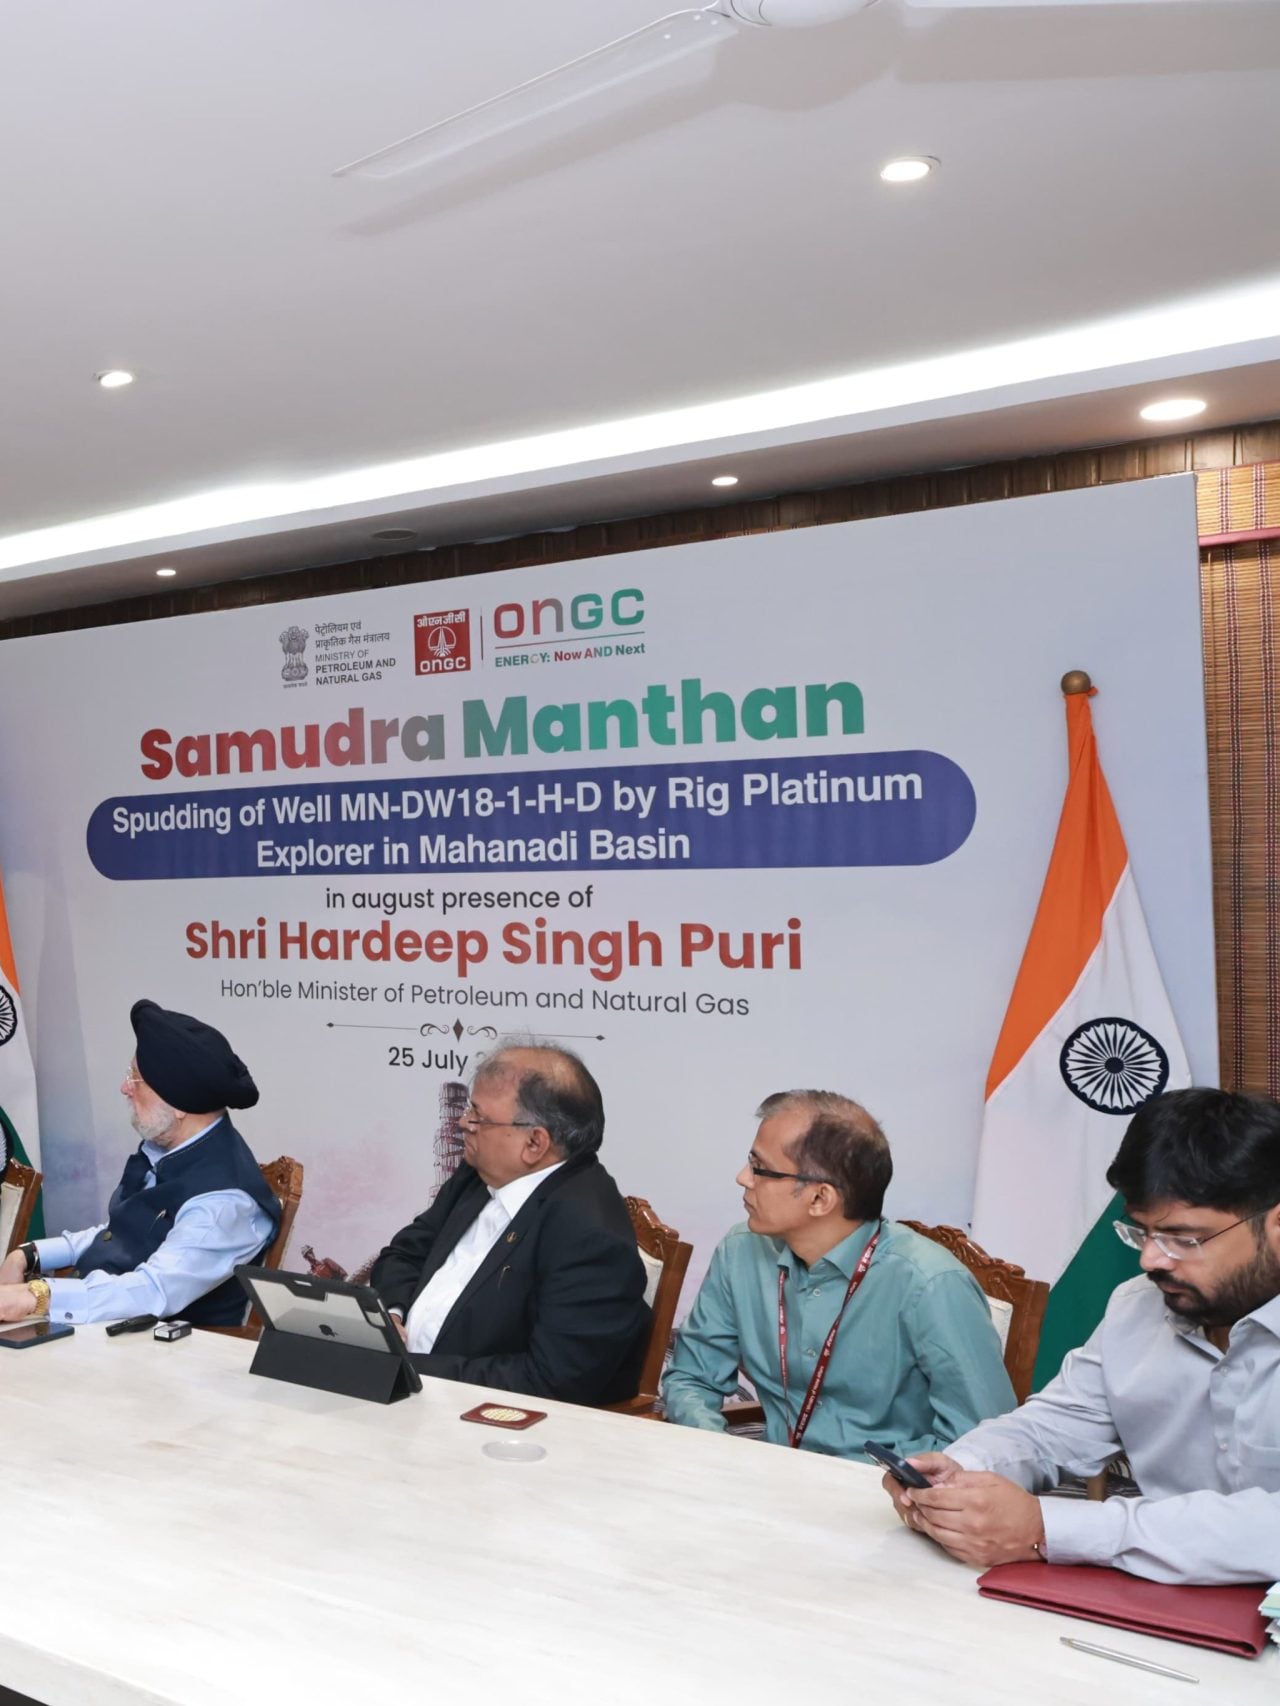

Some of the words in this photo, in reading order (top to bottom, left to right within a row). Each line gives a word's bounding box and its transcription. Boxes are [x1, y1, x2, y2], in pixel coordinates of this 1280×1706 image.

[348, 633, 361, 644] गैस
[363, 632, 390, 643] मंत्रालय
[554, 650, 582, 662] Now
[584, 646, 613, 659] AND
[615, 643, 646, 655] Next
[315, 650, 355, 662] MINISTRY
[357, 649, 369, 659] OF
[315, 660, 373, 674] PETROLEUM
[375, 658, 396, 668] AND
[316, 673, 359, 686] NATURAL
[361, 671, 382, 681] GAS
[140, 707, 446, 780] Samudra
[462, 678, 865, 758] Manthan
[113, 804, 231, 839] Spudding
[239, 799, 266, 826] of
[272, 795, 331, 824] Well
[341, 781, 602, 822] MN-DW18-1-H-D
[613, 780, 656, 818] by
[668, 775, 730, 816] Rig
[743, 770, 922, 807] Platinum
[257, 838, 374, 874] Explorer
[383, 836, 409, 865] in
[420, 831, 578, 864] Mahanadi
[590, 827, 690, 861] Basin
[325, 888, 345, 908] in
[352, 888, 434, 915] august
[442, 890, 560, 915] presence
[568, 885, 594, 908] of
[186, 917, 266, 959] Shri
[279, 919, 488, 978] Hardeep
[502, 917, 663, 981] Singh
[680, 917, 802, 970] Puri
[298, 981, 377, 1002] Minister
[384, 983, 404, 1003] of
[412, 984, 528, 1007] Petroleum
[536, 988, 583, 1009] and
[592, 989, 687, 1013] Natural
[696, 993, 750, 1016] Gas
[388, 1046, 414, 1067] 25
[422, 1049, 468, 1077] July
